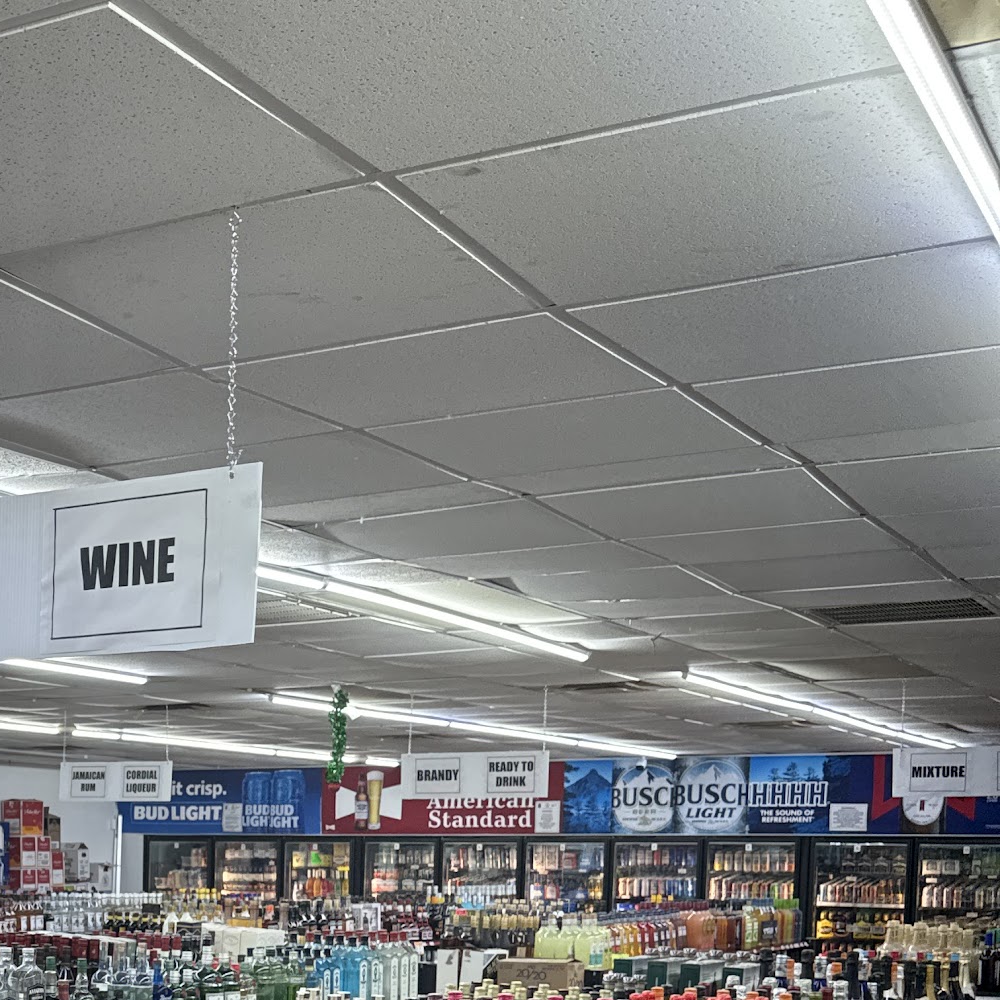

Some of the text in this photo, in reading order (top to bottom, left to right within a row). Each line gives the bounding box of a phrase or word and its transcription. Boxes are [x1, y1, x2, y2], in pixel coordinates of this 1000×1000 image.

[80, 538, 175, 590] WINE
[489, 761, 534, 773] READY TO
[912, 765, 966, 778] MIXTURE
[72, 771, 105, 780] JAMAICAN
[126, 770, 157, 780] CORDIAL
[417, 769, 459, 782] BRANDY
[81, 783, 96, 792] RUM
[496, 776, 526, 787] DRINK
[126, 783, 157, 793] LIQUEUR
[186, 781, 227, 798] crisp.
[675, 783, 749, 806] BUSCH
[133, 805, 169, 821] BUD
[171, 805, 222, 821] LIGHT
[245, 804, 270, 815] BUD
[270, 804, 294, 815] BUD
[686, 807, 736, 819] LIGHT
[428, 809, 532, 829] Standard
[516, 968, 547, 980] 20/20
